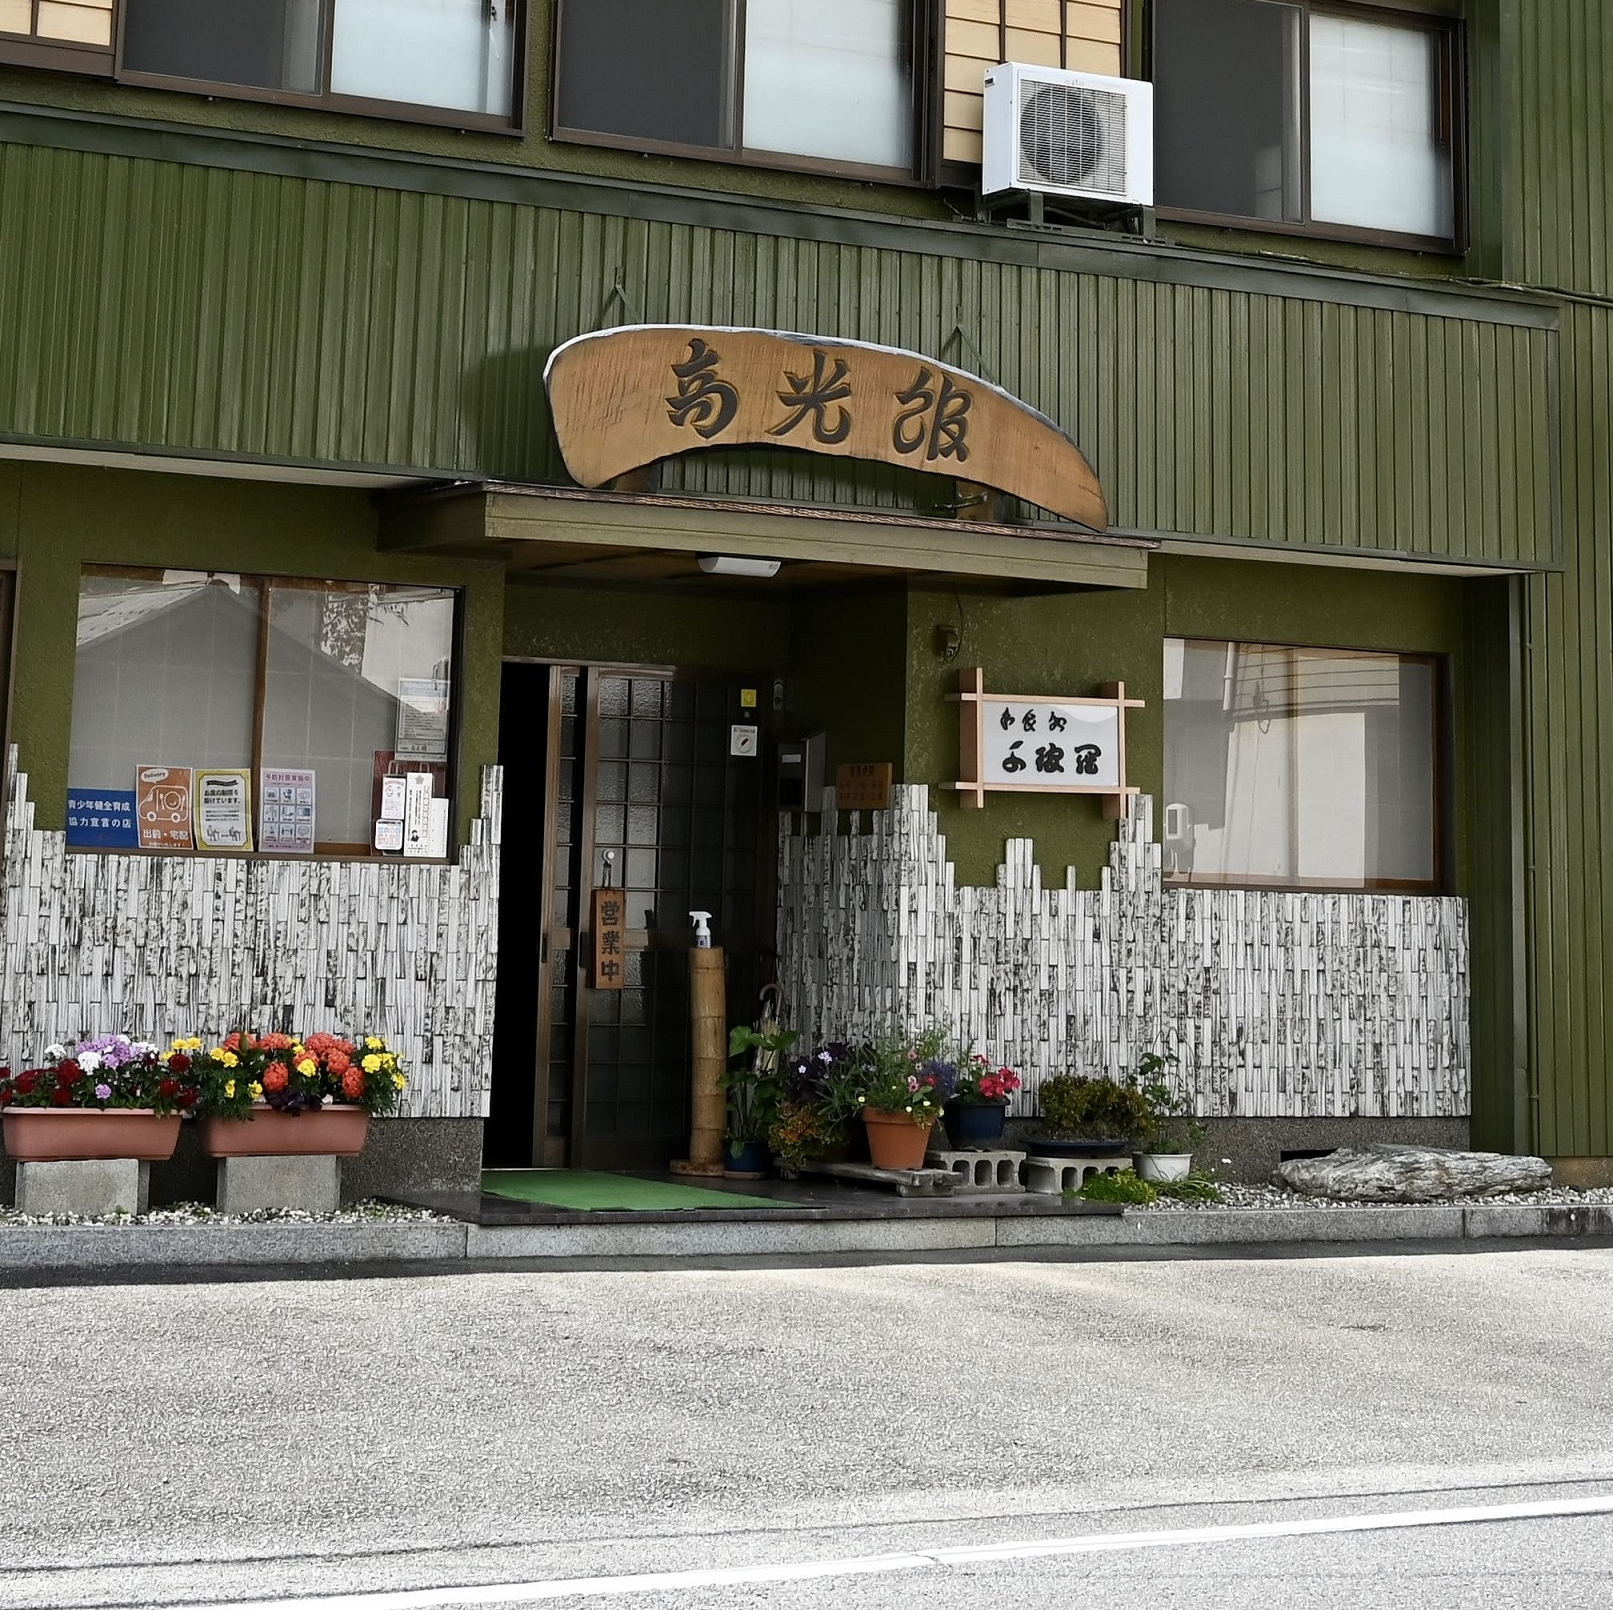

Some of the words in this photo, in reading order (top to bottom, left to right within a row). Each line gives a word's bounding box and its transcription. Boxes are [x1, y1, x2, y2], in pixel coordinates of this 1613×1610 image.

[68, 799, 131, 812] 青少年健全育成
[69, 817, 131, 829] 協力宣言の店
[601, 900, 621, 982] 営業中
